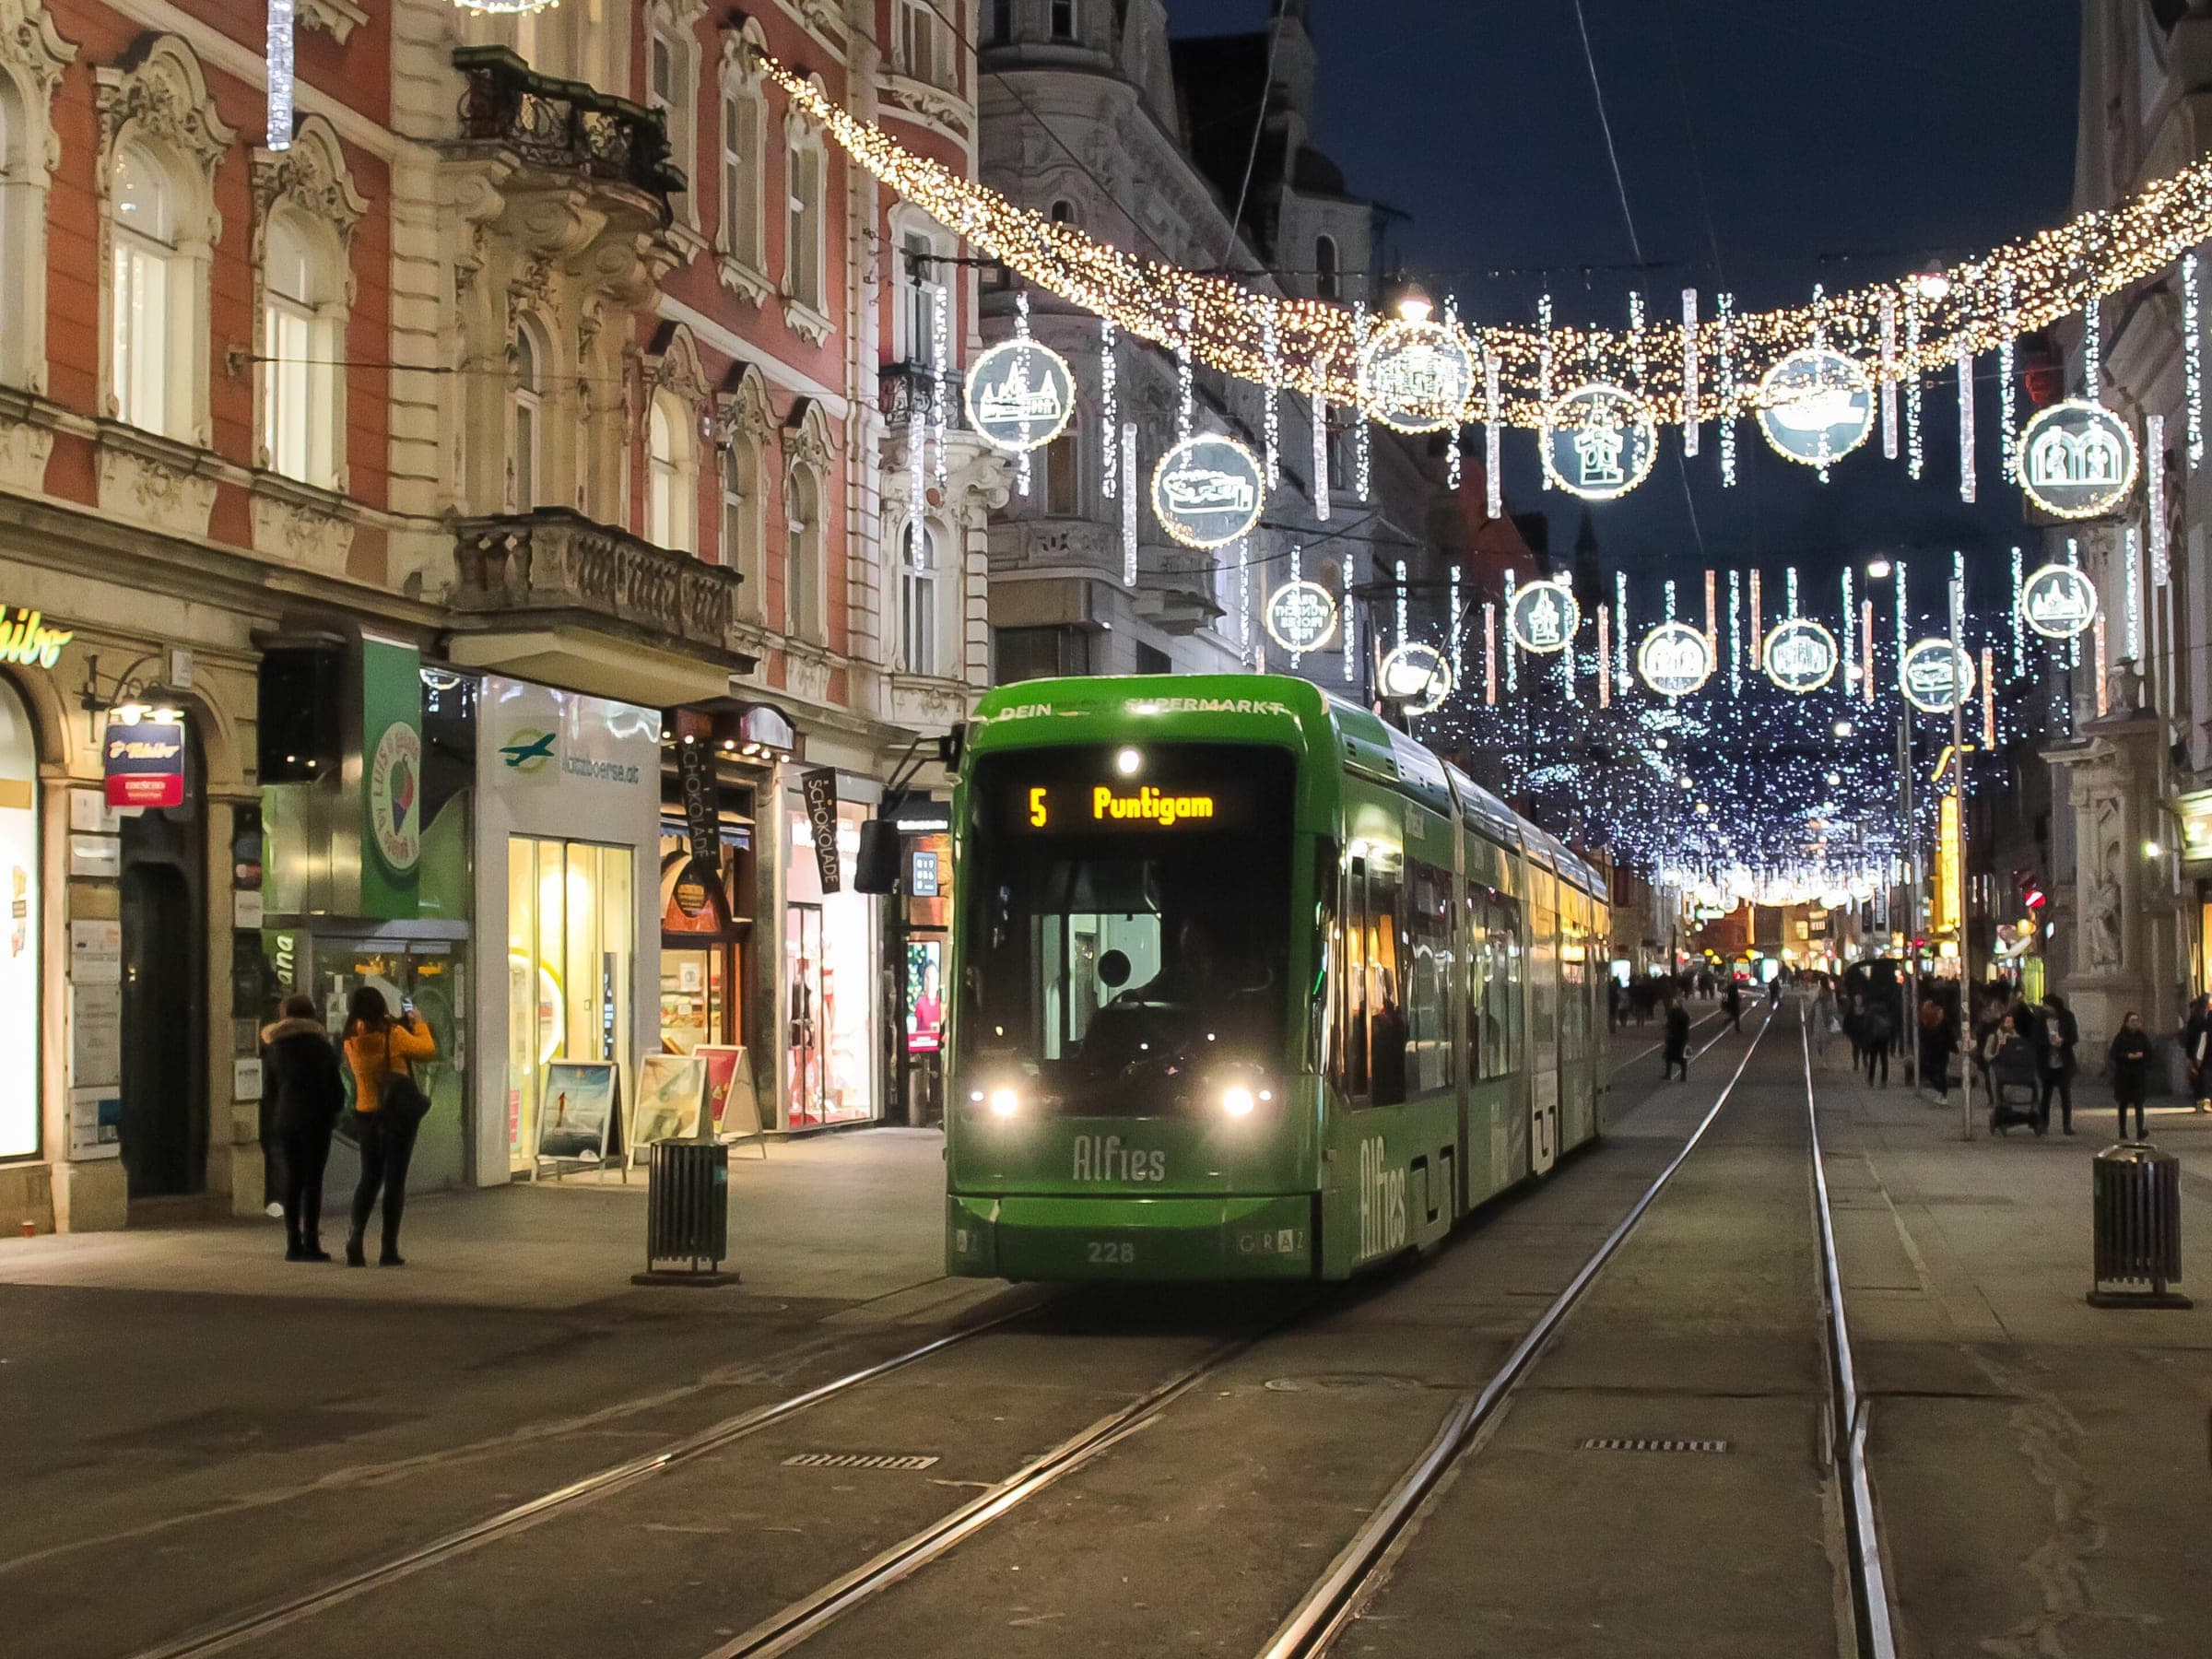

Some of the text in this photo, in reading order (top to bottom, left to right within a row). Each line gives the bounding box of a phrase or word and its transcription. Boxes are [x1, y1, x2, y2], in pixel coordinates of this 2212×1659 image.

[1000, 697, 1285, 720] DEIN SUPERMARKT
[1030, 786, 1214, 827] 5 Puntigam
[807, 779, 840, 884] SCHOKOLADE
[1072, 1135, 1167, 1182] Alfies
[1359, 1135, 1406, 1262] Alfies
[1087, 1242, 1136, 1264] 228
[1239, 1229, 1305, 1253] GRAZ
